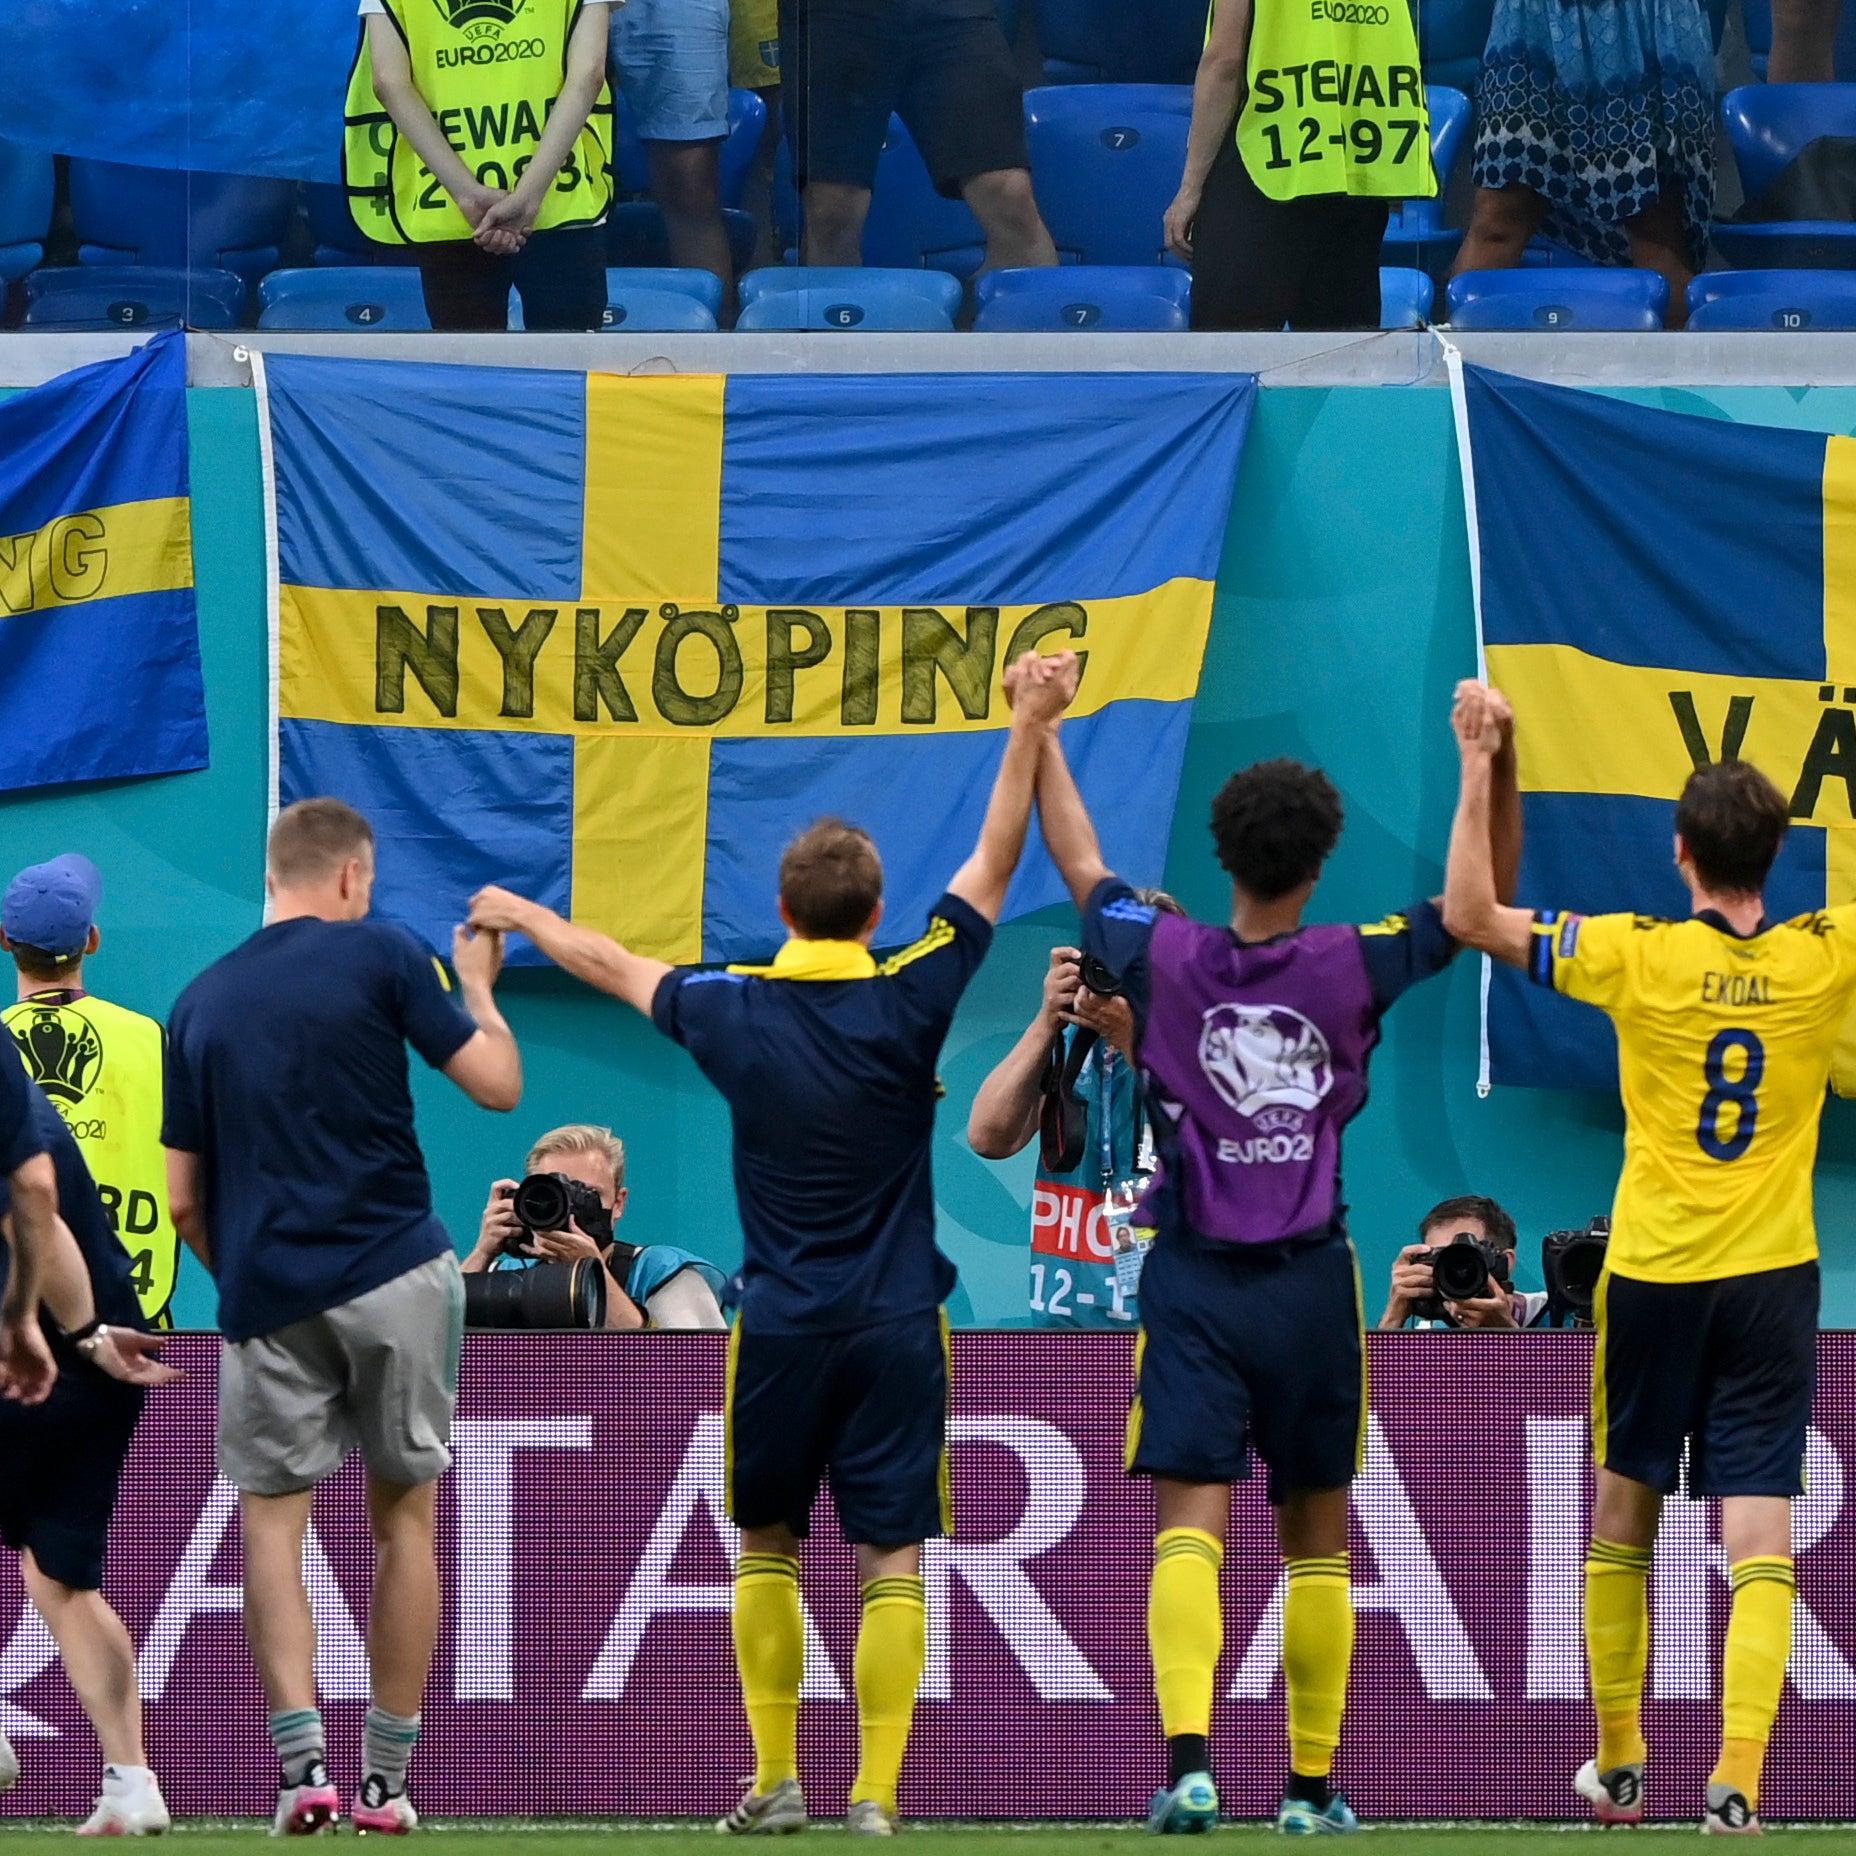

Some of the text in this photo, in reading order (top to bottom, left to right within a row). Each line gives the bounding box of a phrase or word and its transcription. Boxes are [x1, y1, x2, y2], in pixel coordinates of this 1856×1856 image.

[464, 26, 502, 42] UEFA
[436, 38, 546, 70] EURO2020
[1253, 58, 1430, 115] STEWAR
[1114, 133, 1126, 147] 7
[122, 307, 134, 322] 3
[358, 307, 371, 322] 4
[602, 309, 614, 324] 5
[839, 309, 851, 324] 6
[1076, 310, 1088, 323] 7
[1548, 312, 1559, 324] 9
[1783, 312, 1801, 326] 10
[375, 600, 1089, 727] NYKÖPING
[1701, 970, 1776, 1006] EKDAL
[1694, 1027, 1765, 1162] 8
[1217, 1133, 1316, 1164] EURO2
[1032, 1188, 1115, 1259] PHO
[1029, 1264, 1132, 1320] 12-1
